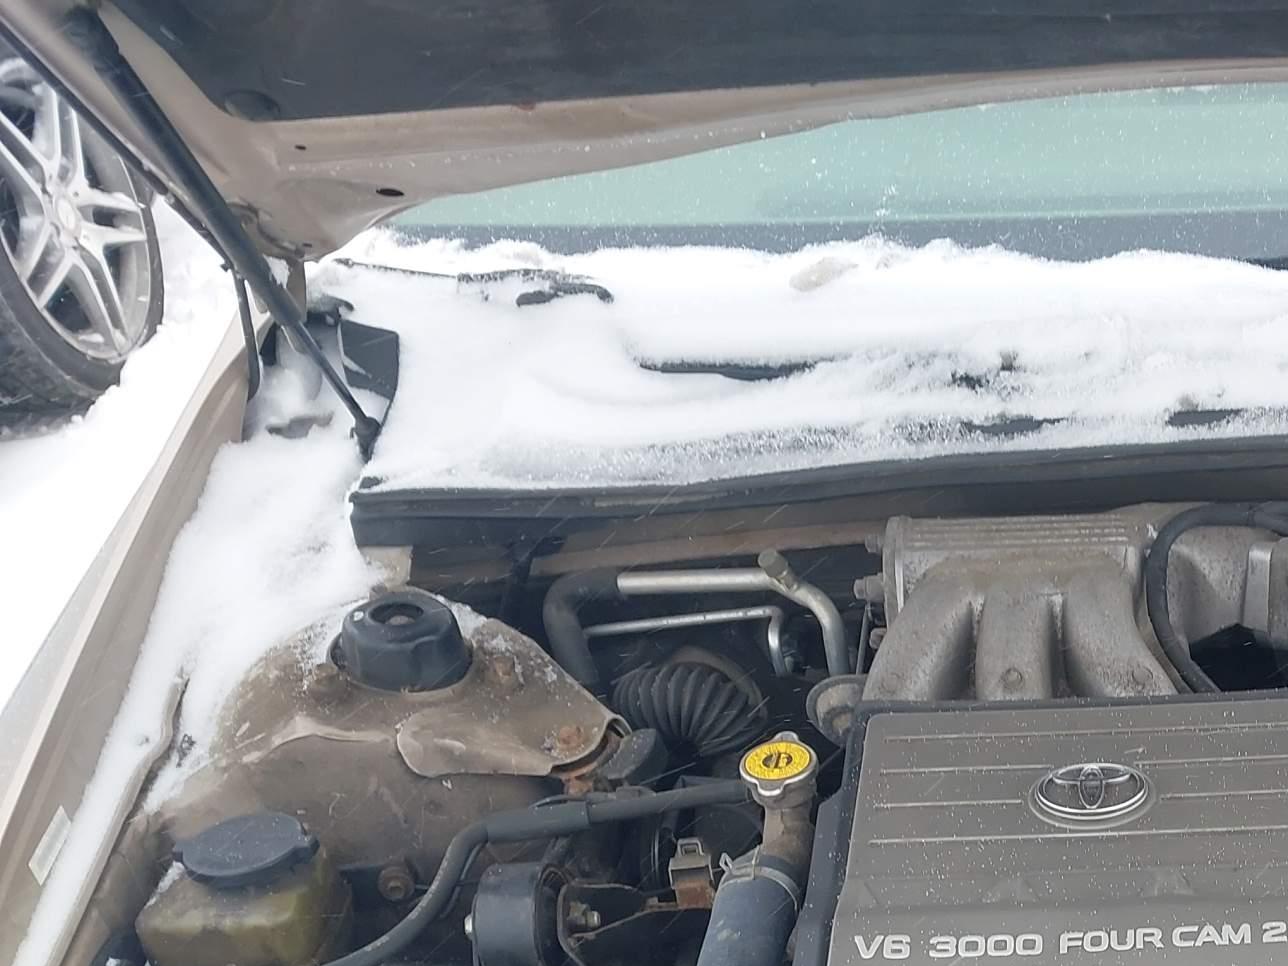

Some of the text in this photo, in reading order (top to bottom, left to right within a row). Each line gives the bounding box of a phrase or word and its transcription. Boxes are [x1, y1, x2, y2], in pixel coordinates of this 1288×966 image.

[854, 935, 910, 959] V6
[929, 933, 1042, 957] 3000
[1060, 927, 1163, 953] FOUR
[1172, 922, 1251, 945] CAM
